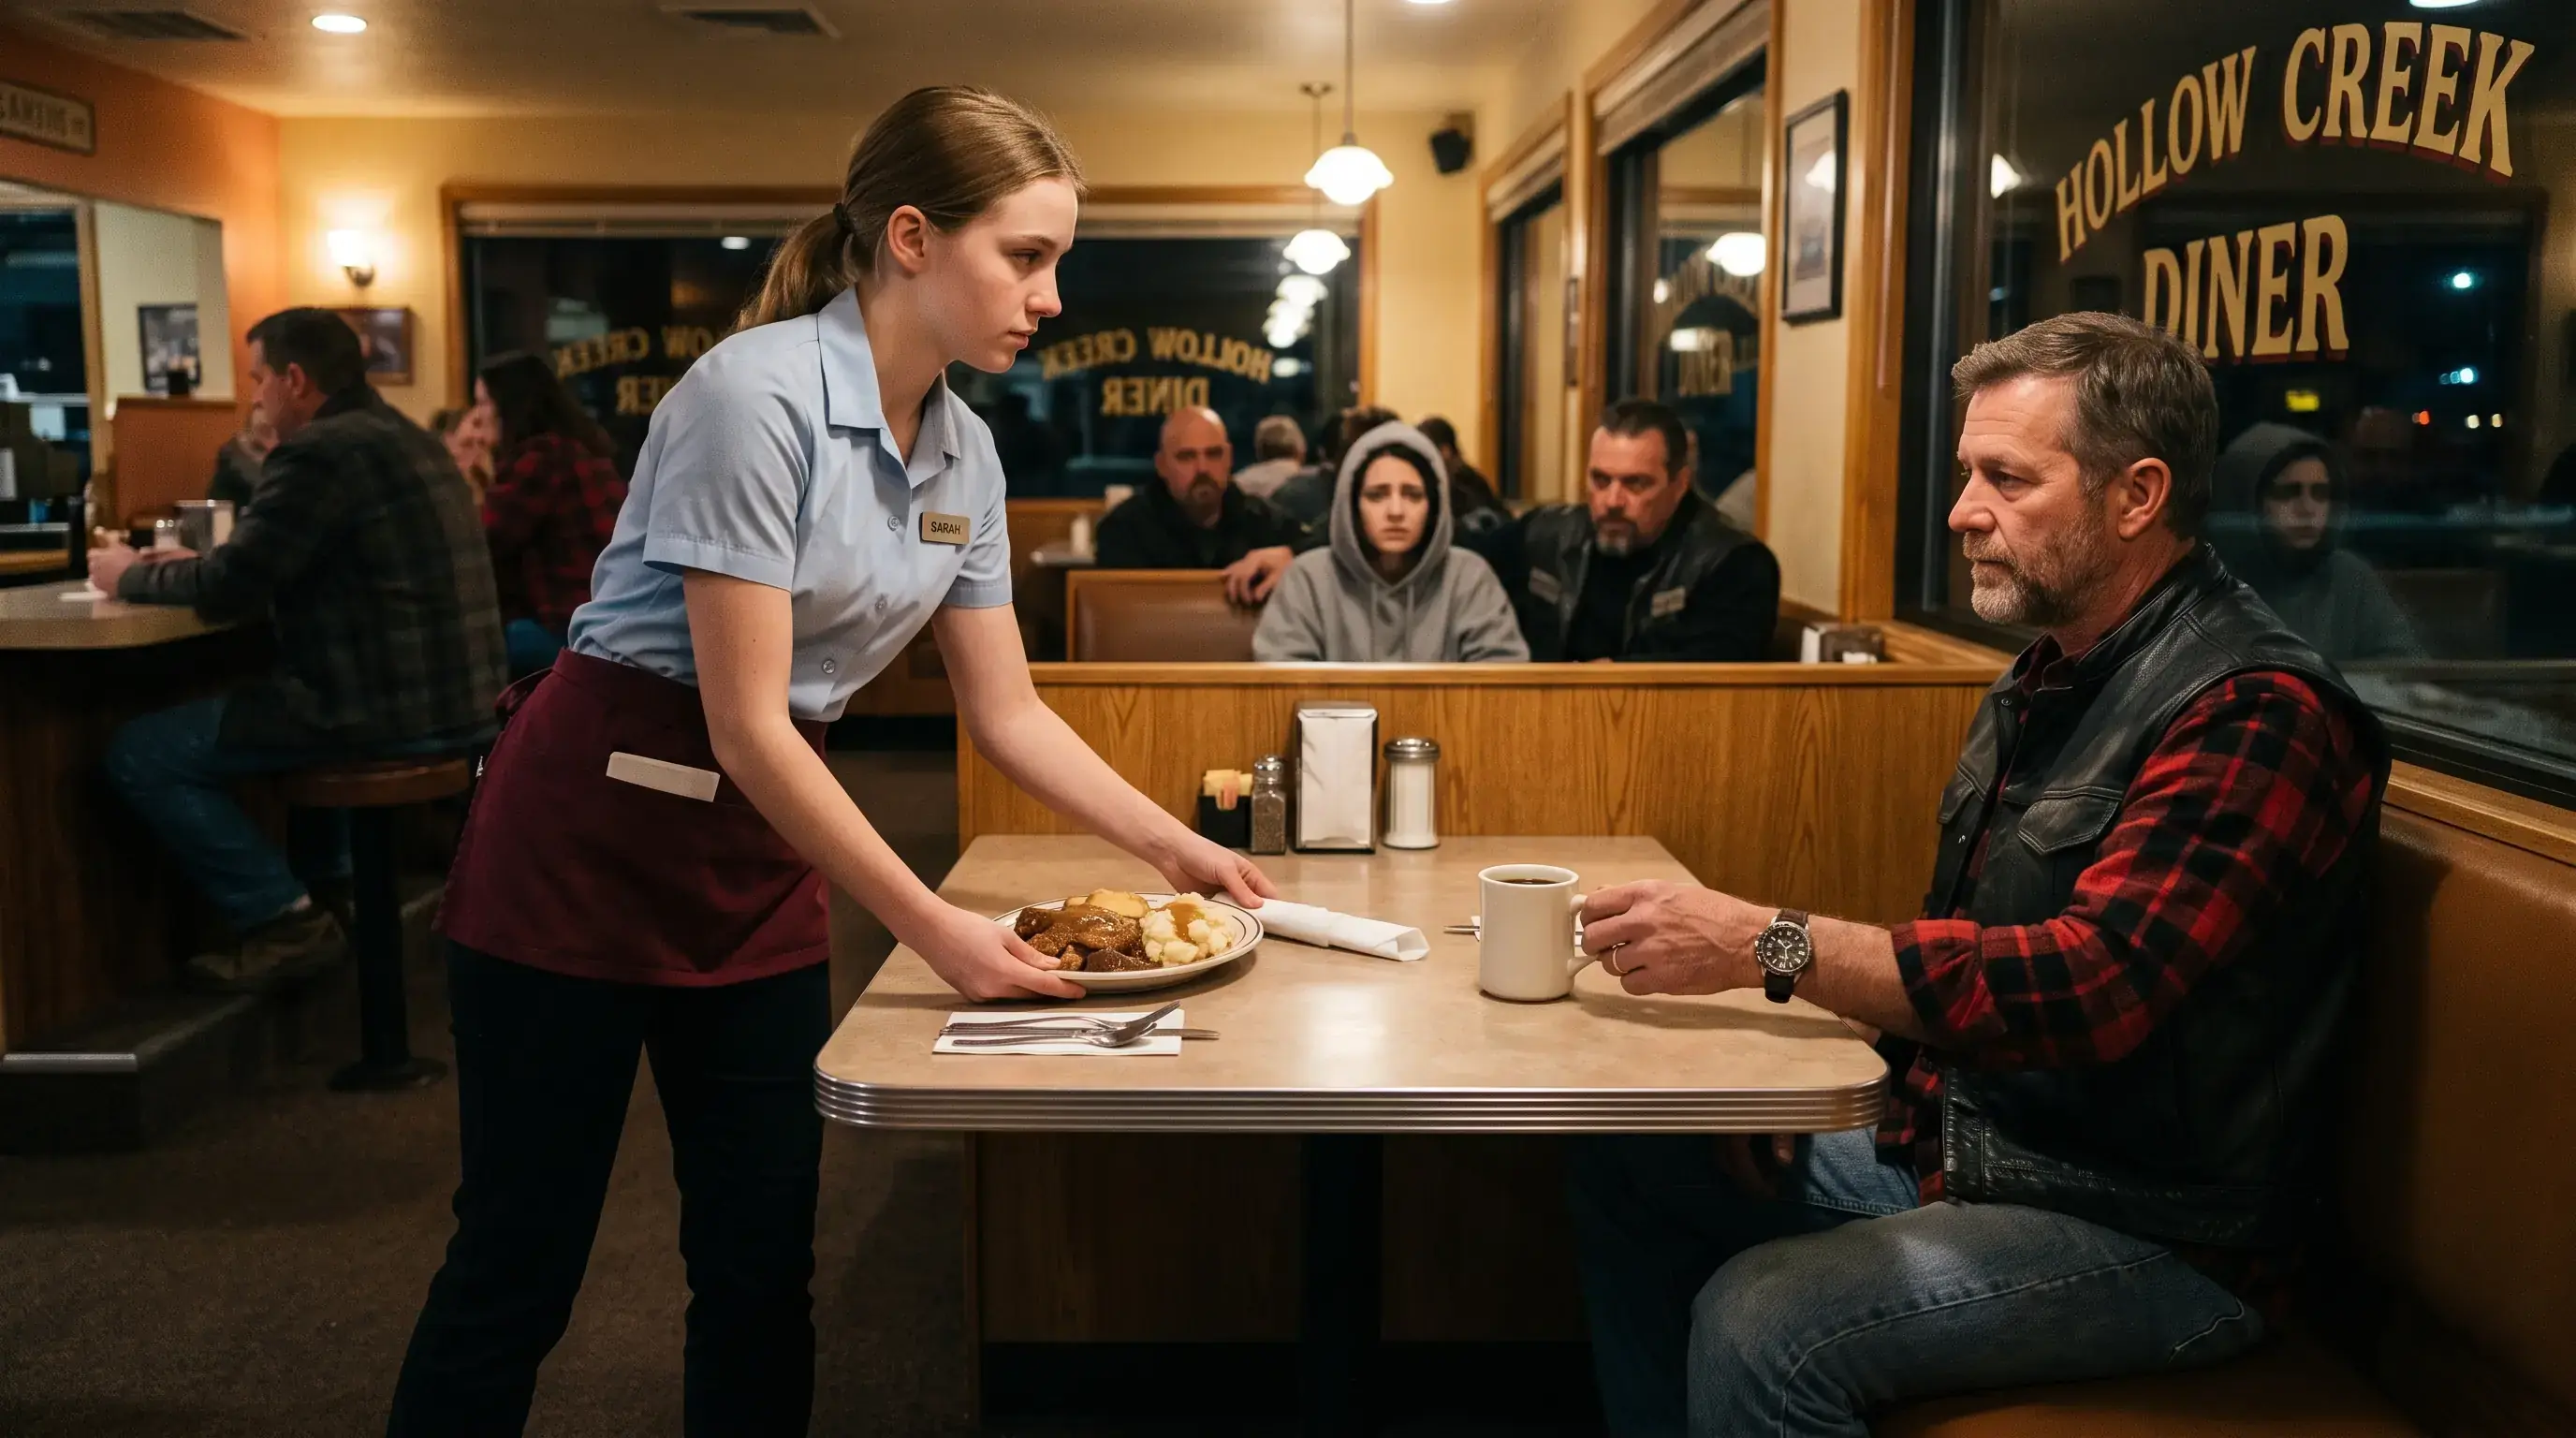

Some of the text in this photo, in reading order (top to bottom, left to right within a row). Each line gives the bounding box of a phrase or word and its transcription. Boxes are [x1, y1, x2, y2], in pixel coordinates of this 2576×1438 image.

[2055, 22, 2535, 265] HOLLOW CREEK
[2144, 213, 2349, 364] DINER
[930, 521, 961, 535] SARAH
